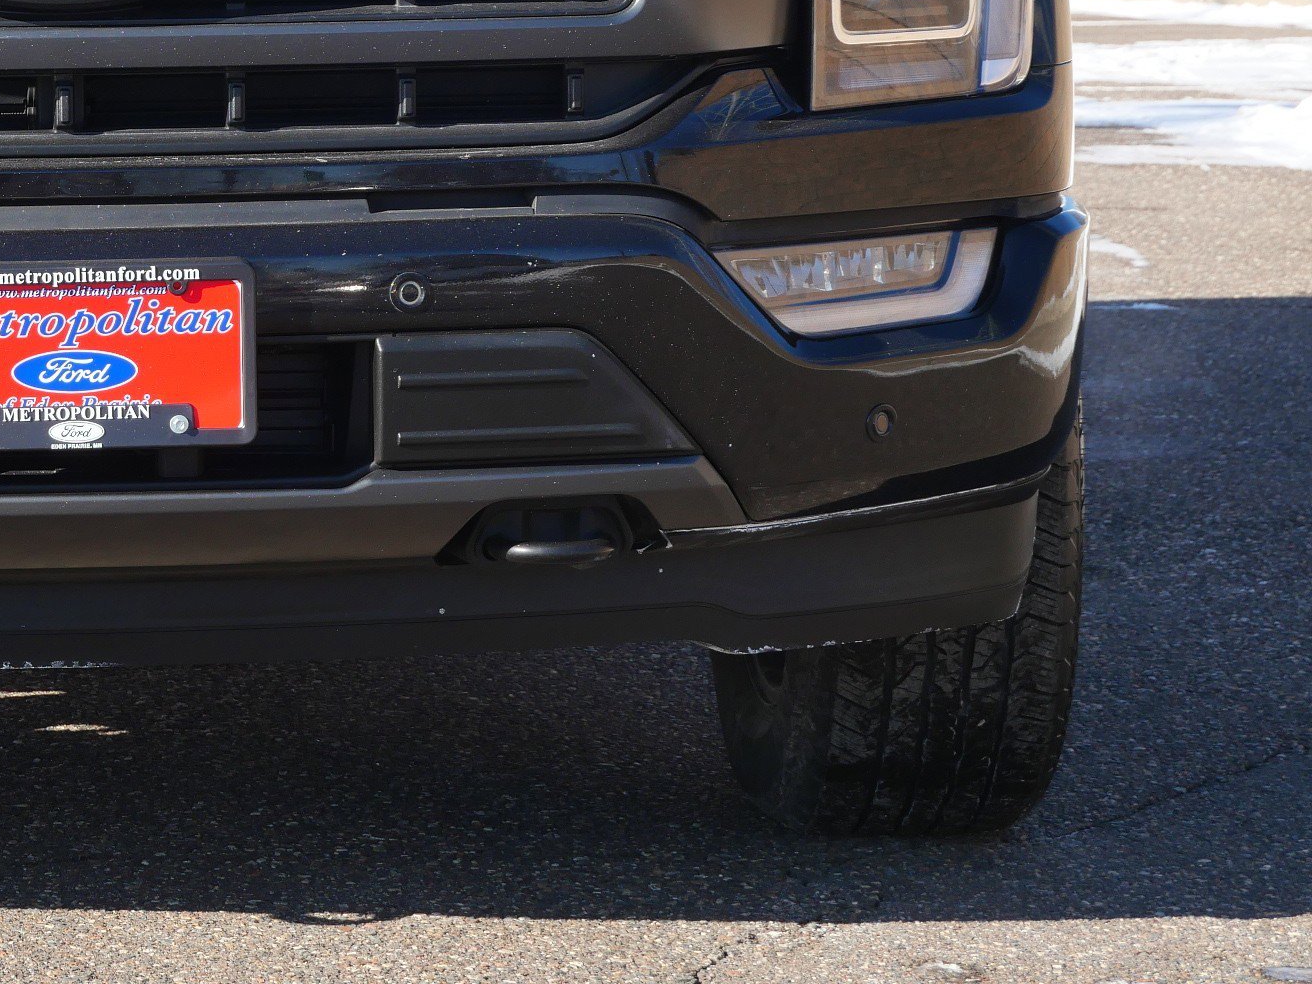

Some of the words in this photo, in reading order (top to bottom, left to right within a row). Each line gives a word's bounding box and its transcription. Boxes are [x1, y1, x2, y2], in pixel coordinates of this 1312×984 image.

[38, 357, 112, 384] Ford
[2, 404, 151, 422] METROPOLITAN
[61, 424, 93, 438] Ford
